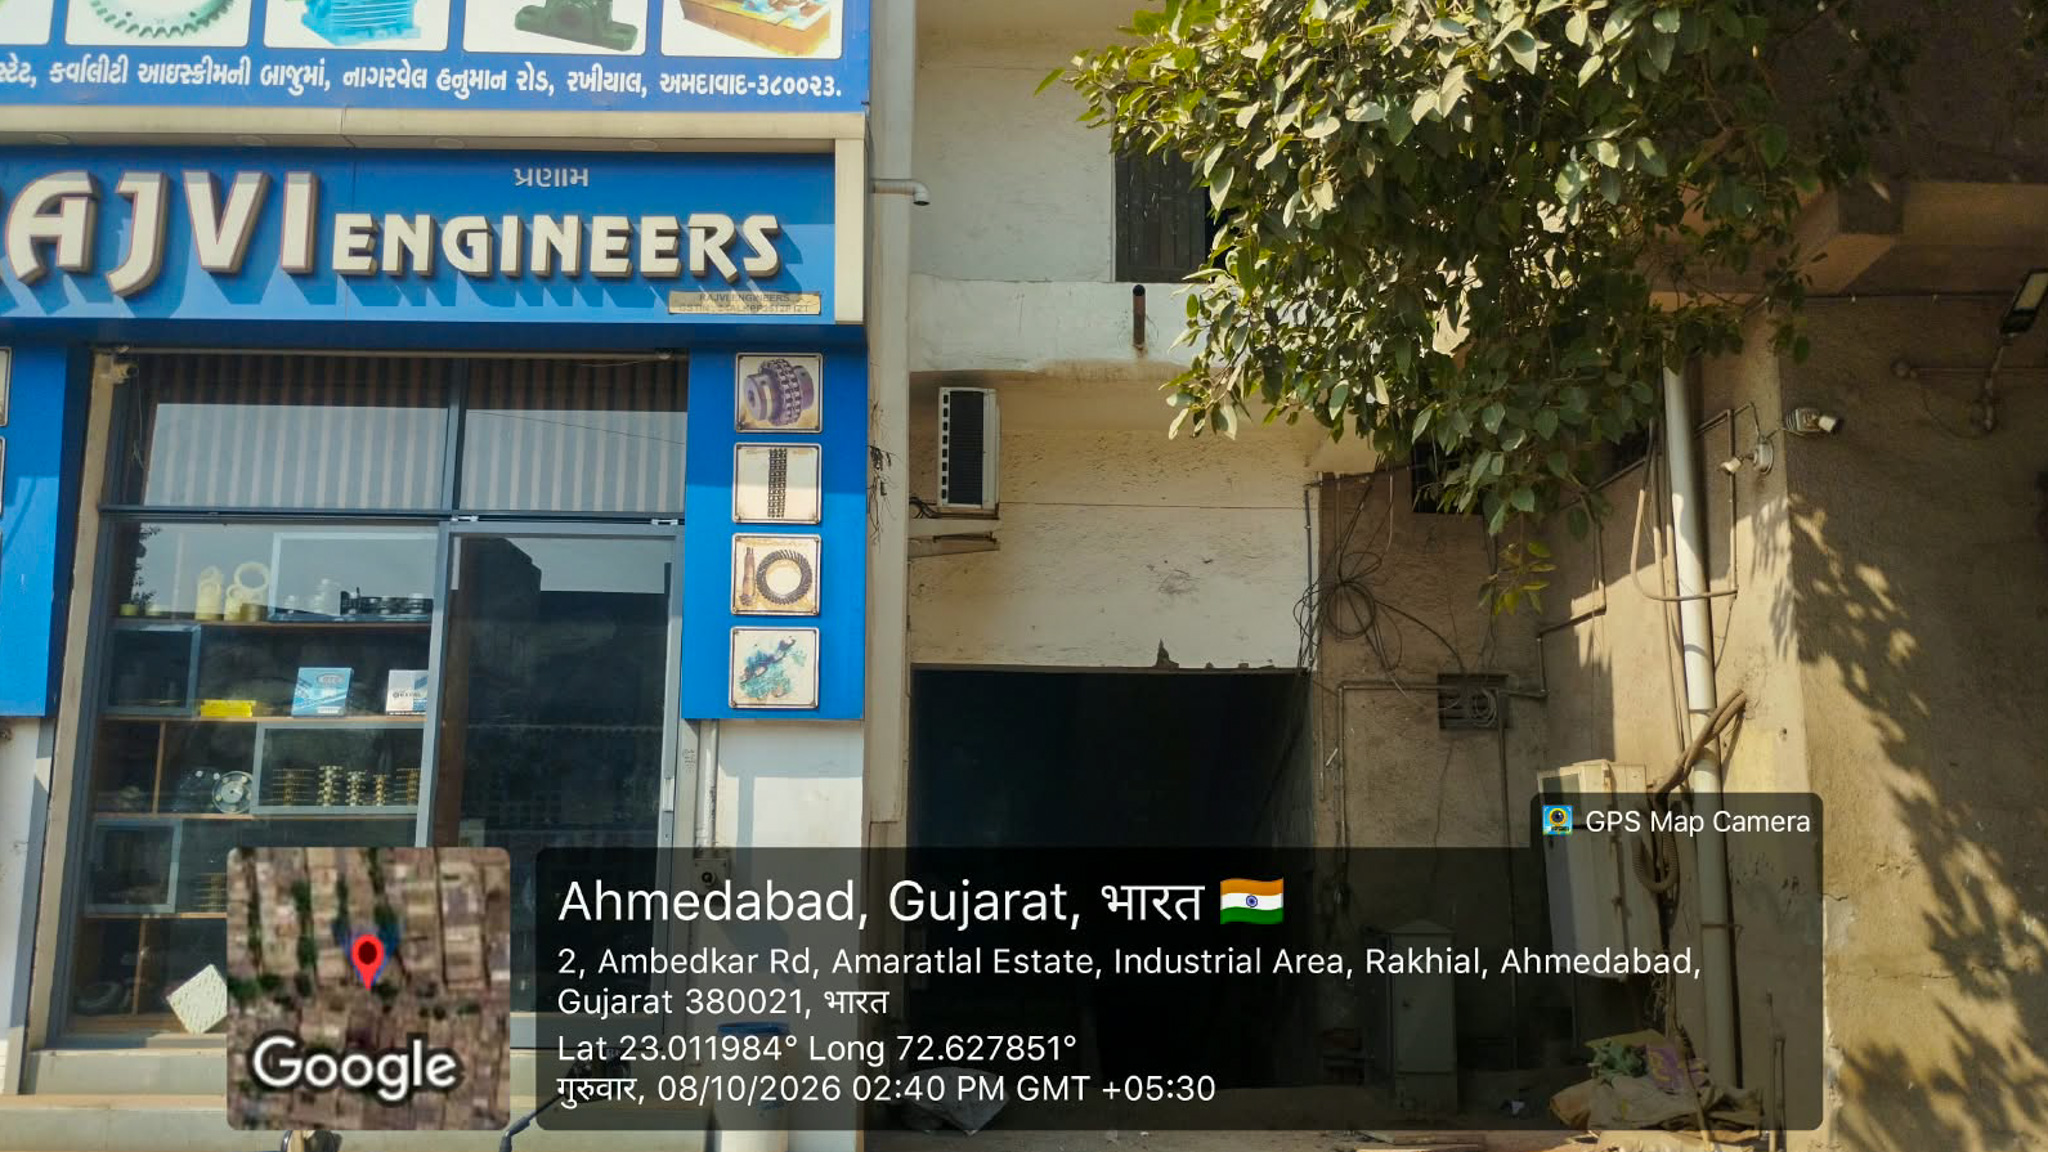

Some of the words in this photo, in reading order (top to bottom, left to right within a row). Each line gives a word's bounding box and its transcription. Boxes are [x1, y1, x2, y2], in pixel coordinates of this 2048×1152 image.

[260, 57, 331, 96] બાજુમાં,
[343, 58, 428, 90] નાગરવેલ
[436, 67, 508, 100] હનુમાન
[516, 61, 555, 97] રોડ,
[567, 62, 648, 98] રખીયાલ,
[659, 72, 843, 97] અમદાવાદ-૩૮૦૦૨૩.
[513, 167, 589, 188] પ્રણામ
[332, 213, 782, 284] ENGINEERS
